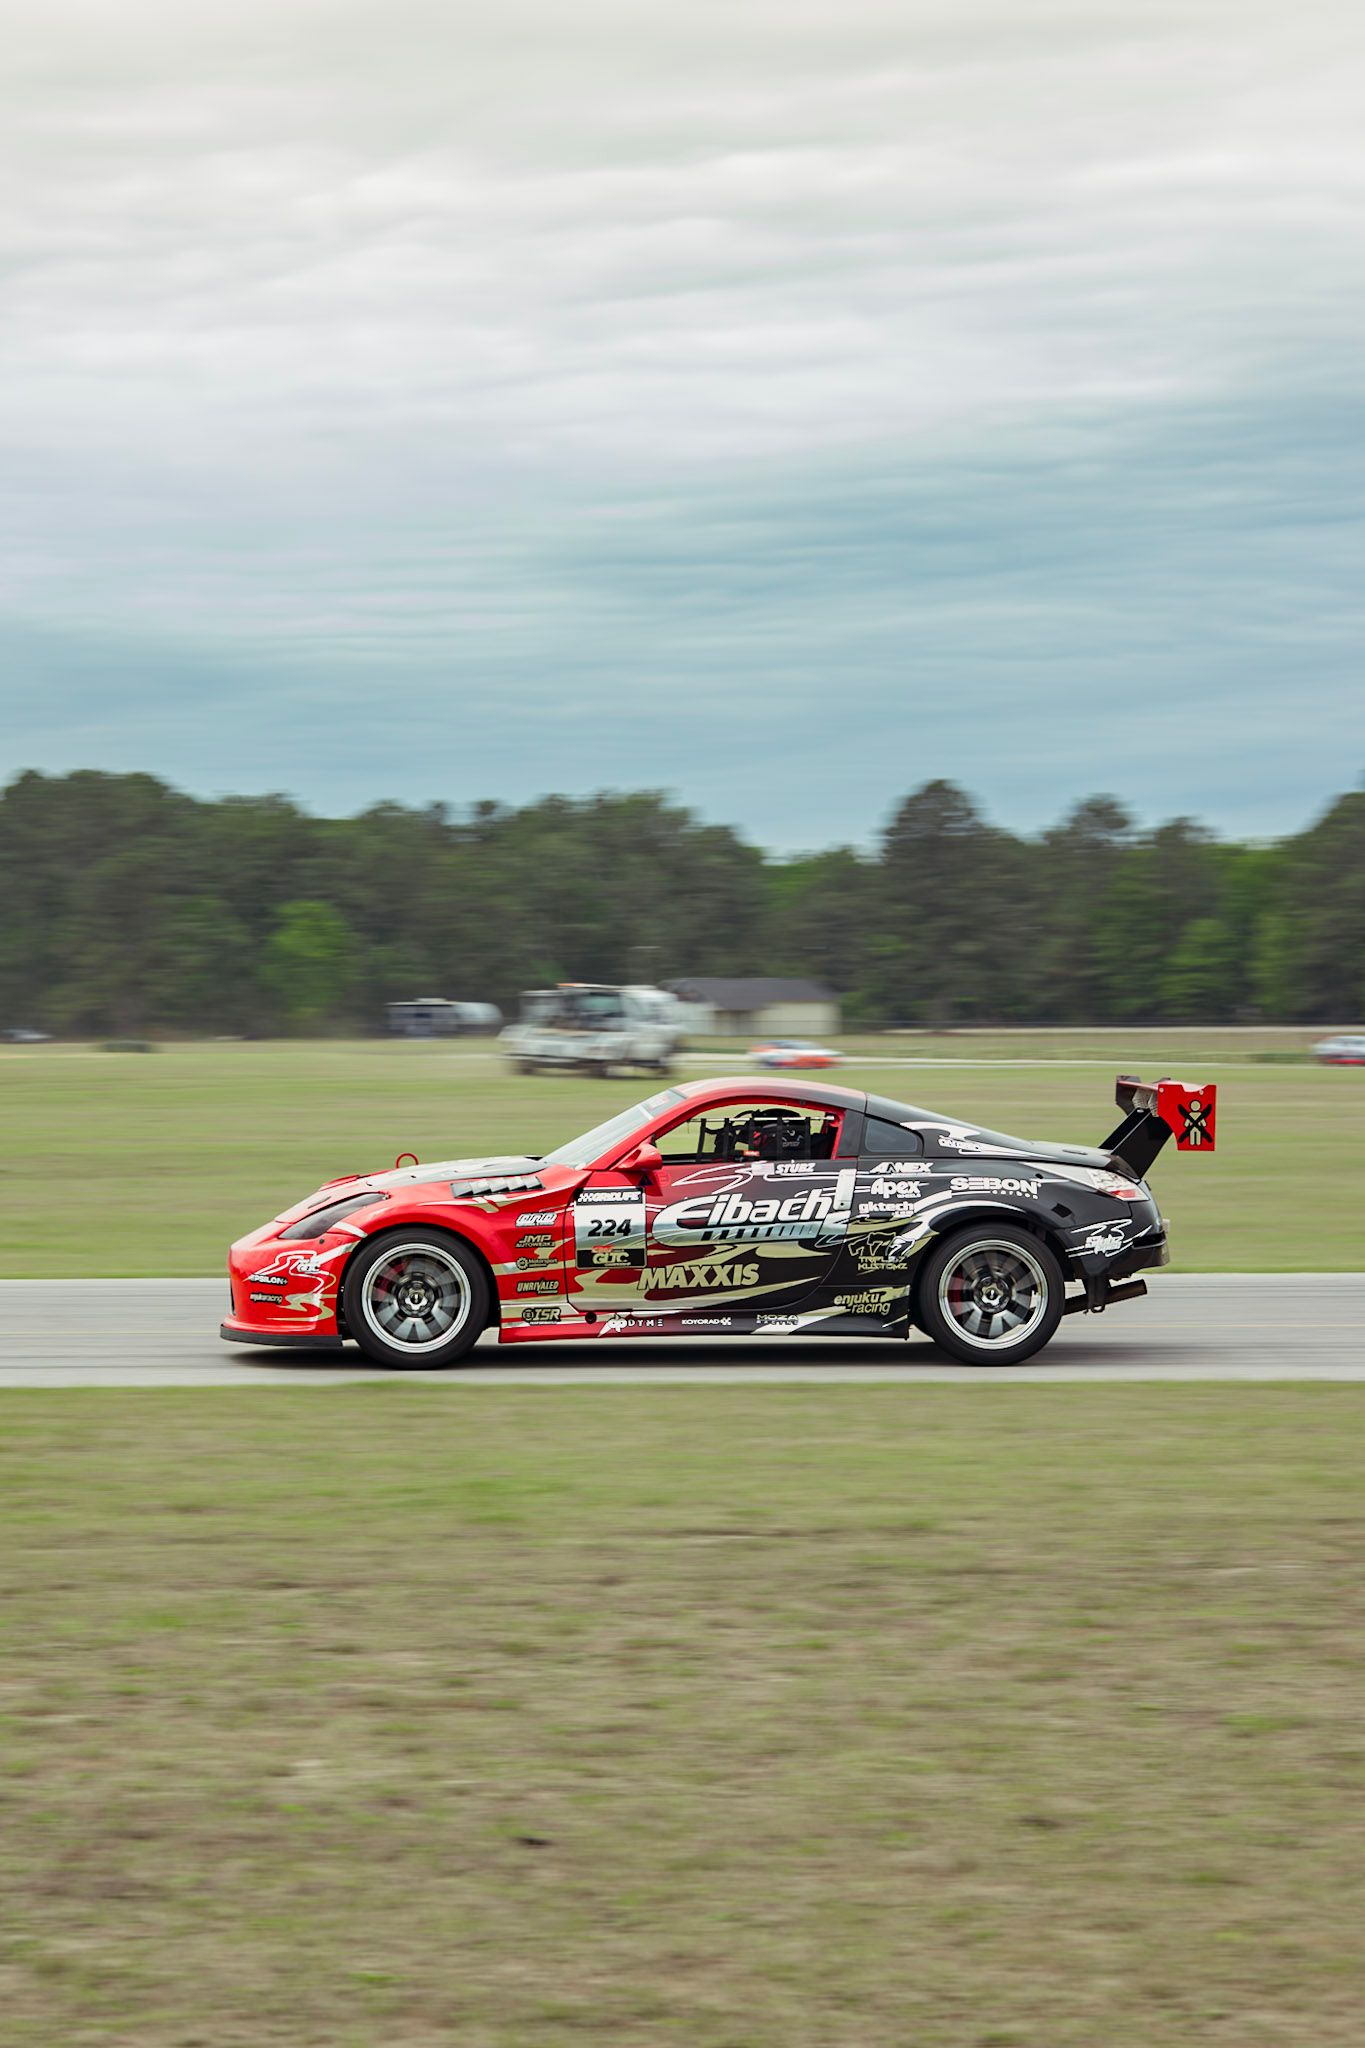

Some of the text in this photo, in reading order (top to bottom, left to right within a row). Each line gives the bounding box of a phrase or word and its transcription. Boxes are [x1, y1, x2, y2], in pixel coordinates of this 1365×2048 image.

[871, 1178, 921, 1198] Apex
[950, 1177, 1038, 1194] SEBON
[652, 1189, 833, 1240] Eibach
[859, 1202, 914, 1214] gktech
[588, 1219, 632, 1237] 224
[519, 1235, 552, 1243] JMP
[637, 1263, 760, 1290] MAXXIS
[517, 1281, 559, 1293] UNRIVALED
[833, 1292, 880, 1307] enjuku
[533, 1309, 560, 1321] ISR
[851, 1303, 891, 1315] racing
